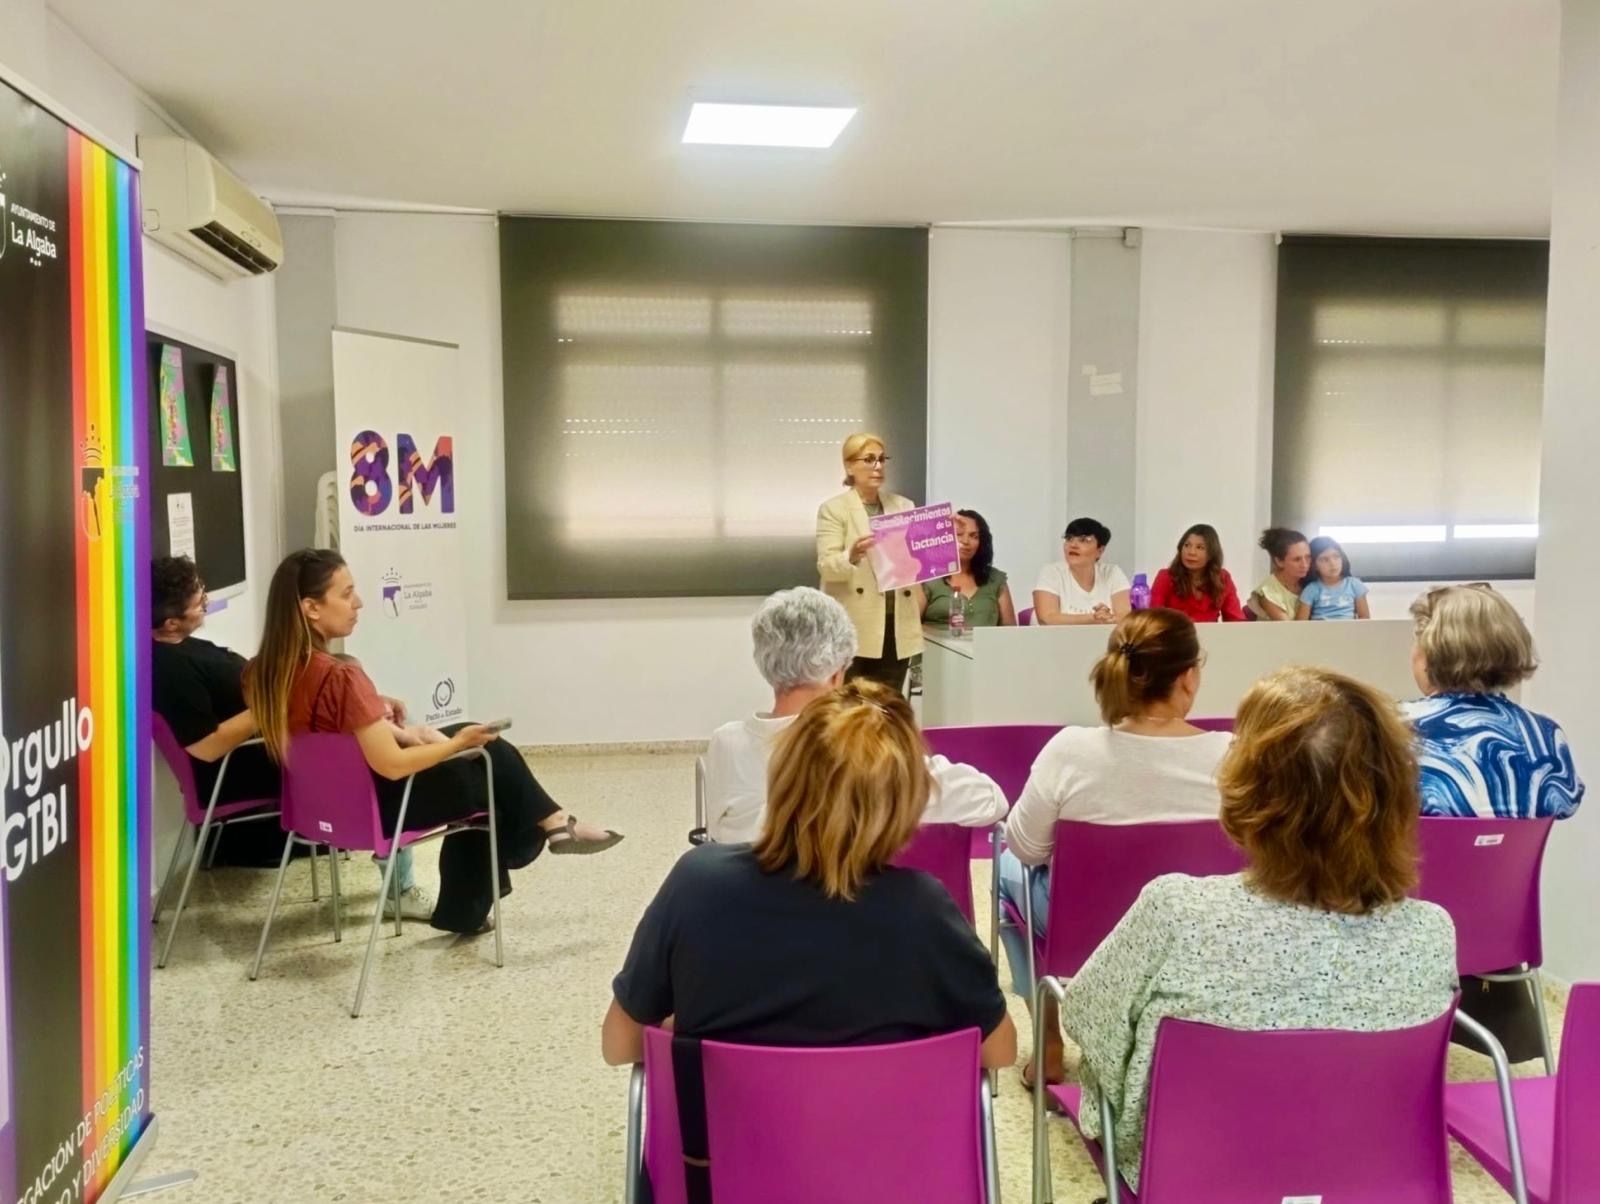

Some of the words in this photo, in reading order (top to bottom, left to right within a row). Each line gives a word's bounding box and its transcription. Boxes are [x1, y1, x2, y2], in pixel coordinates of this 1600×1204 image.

[11, 221, 24, 246] La
[26, 228, 57, 258] Algaba
[350, 430, 455, 516] 8M
[366, 523, 412, 532] INTERNACIONAL
[413, 522, 420, 530] DE
[421, 522, 431, 530] LAS
[433, 521, 456, 529] MUJERES
[936, 521, 944, 530] de
[945, 520, 952, 528] la
[911, 531, 954, 551] lactancia
[77, 1112, 92, 1147] DE
[72, 1170, 81, 1198] Y
